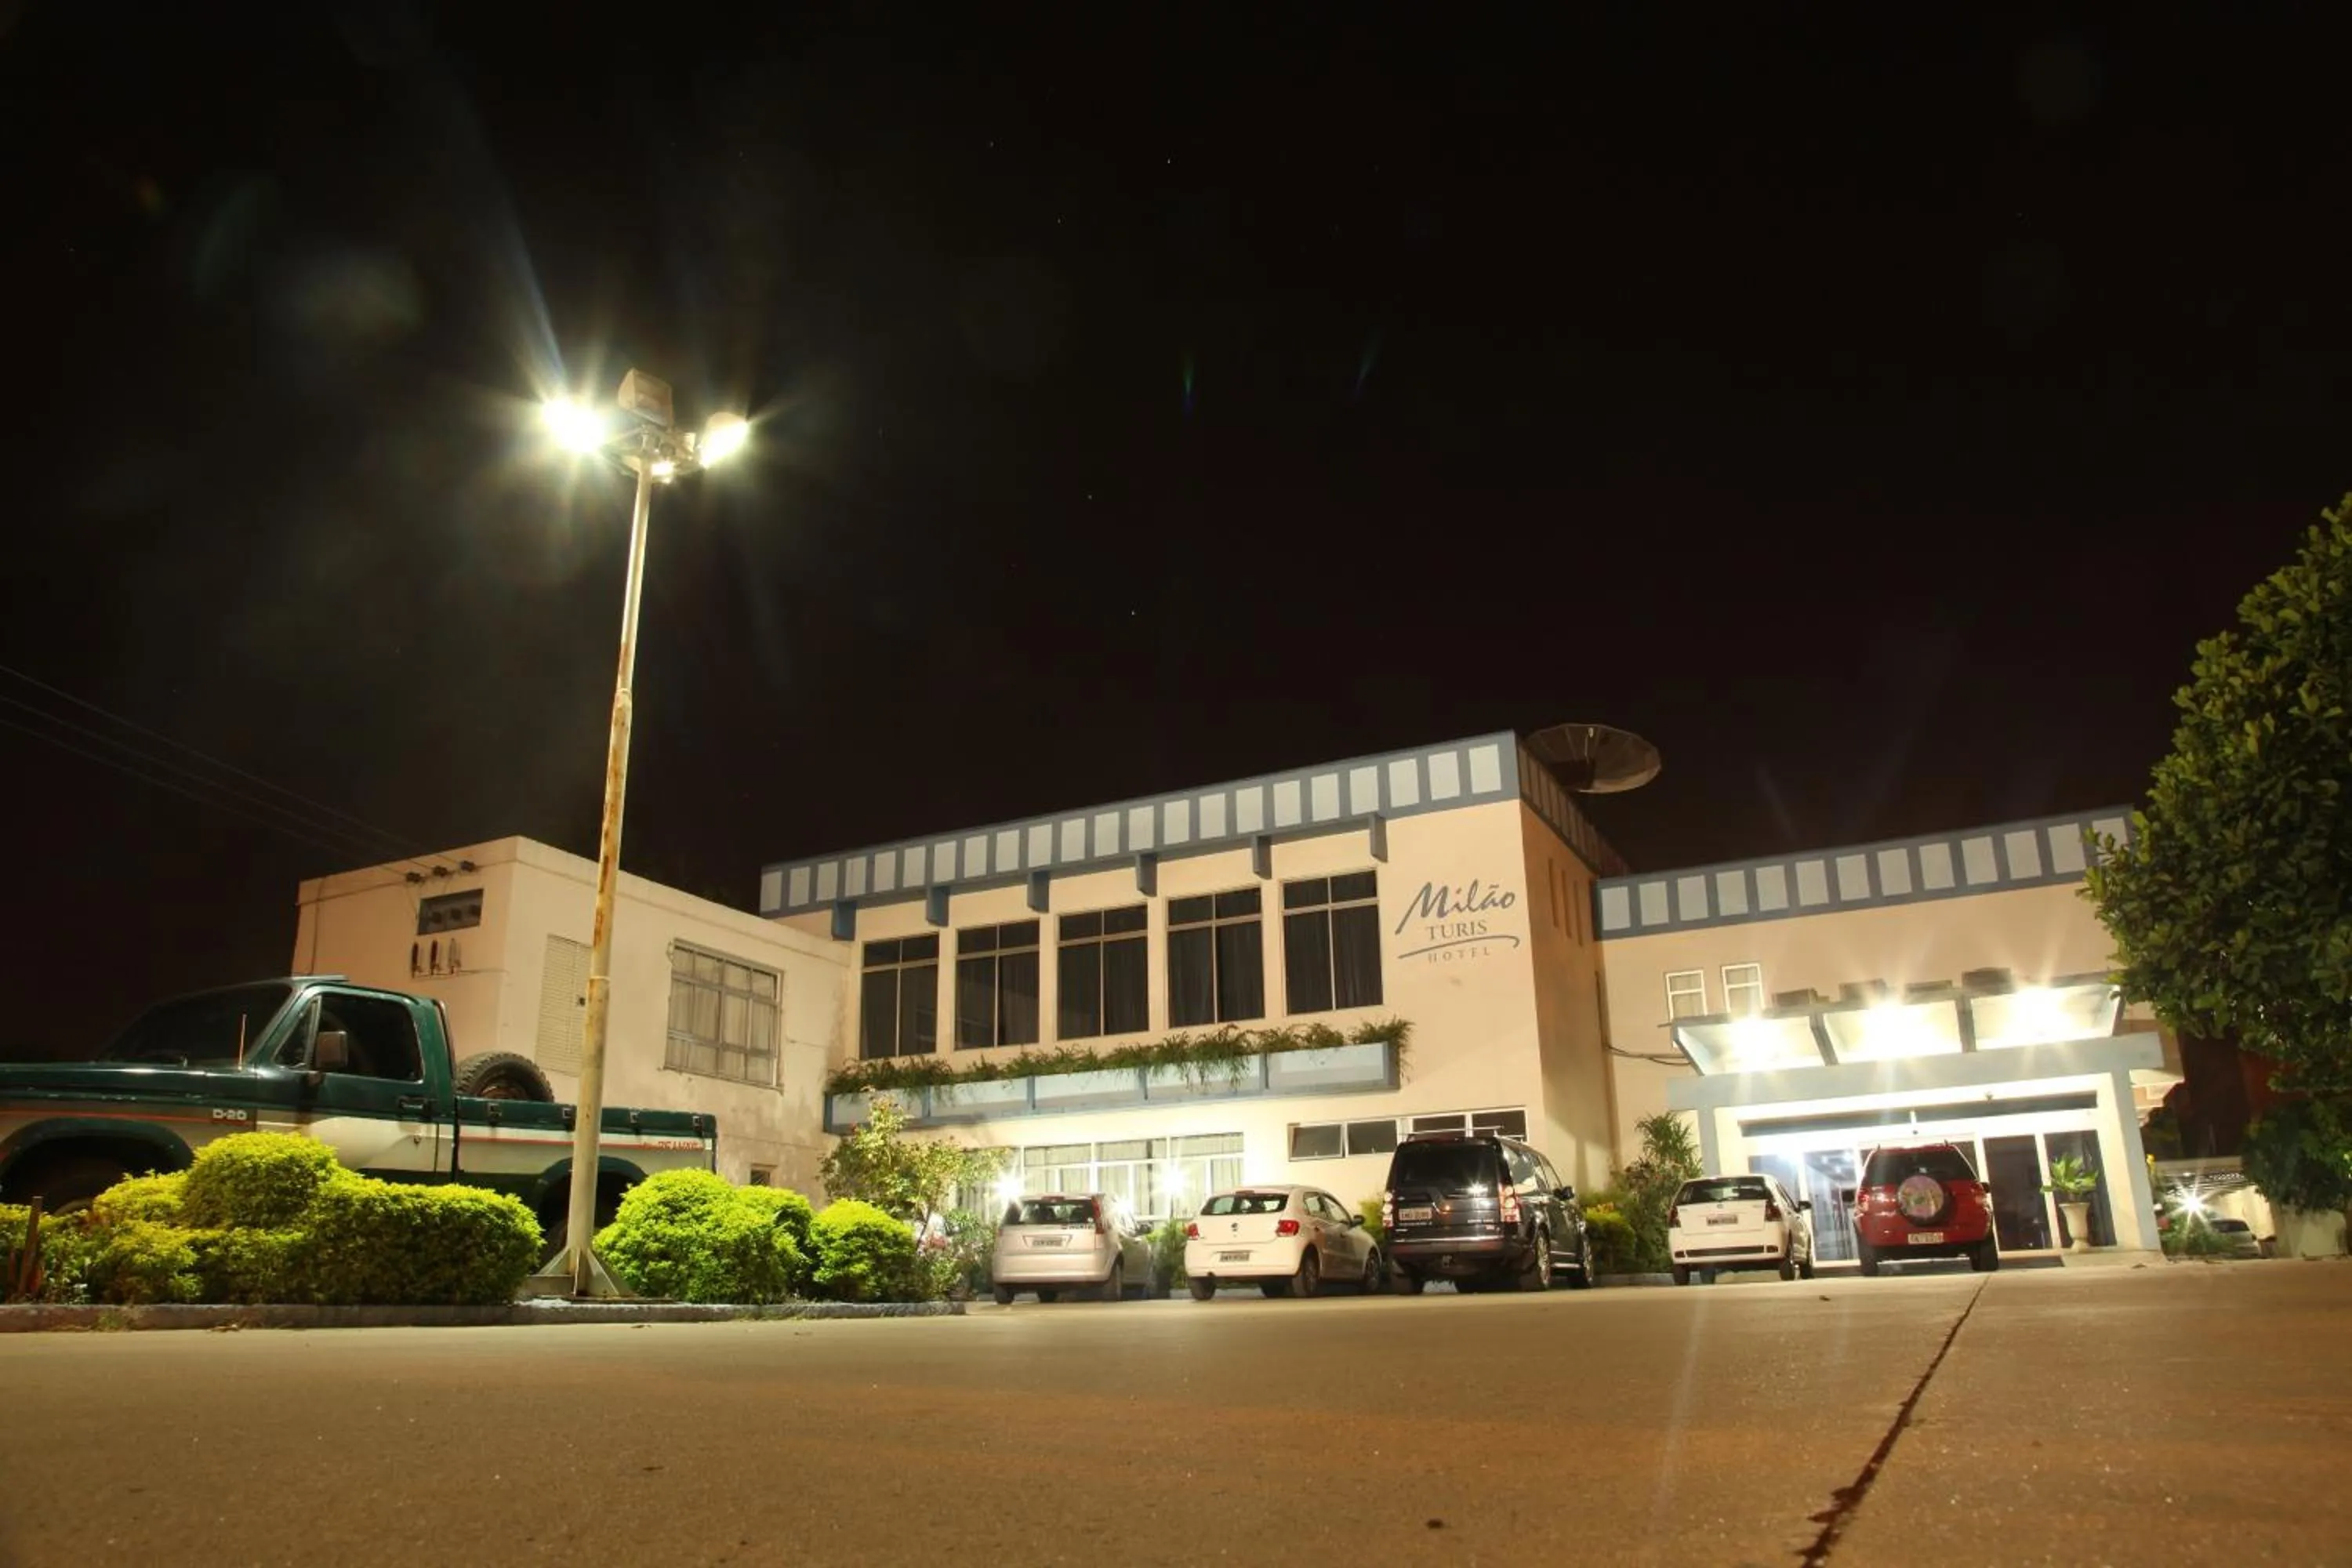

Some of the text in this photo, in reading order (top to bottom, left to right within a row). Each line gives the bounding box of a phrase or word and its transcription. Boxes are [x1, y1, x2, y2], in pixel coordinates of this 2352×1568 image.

[1395, 878, 1515, 935] Milão
[1426, 920, 1487, 940] TURIS
[1428, 946, 1490, 963] HOTEL
[212, 1109, 248, 1120] D-20
